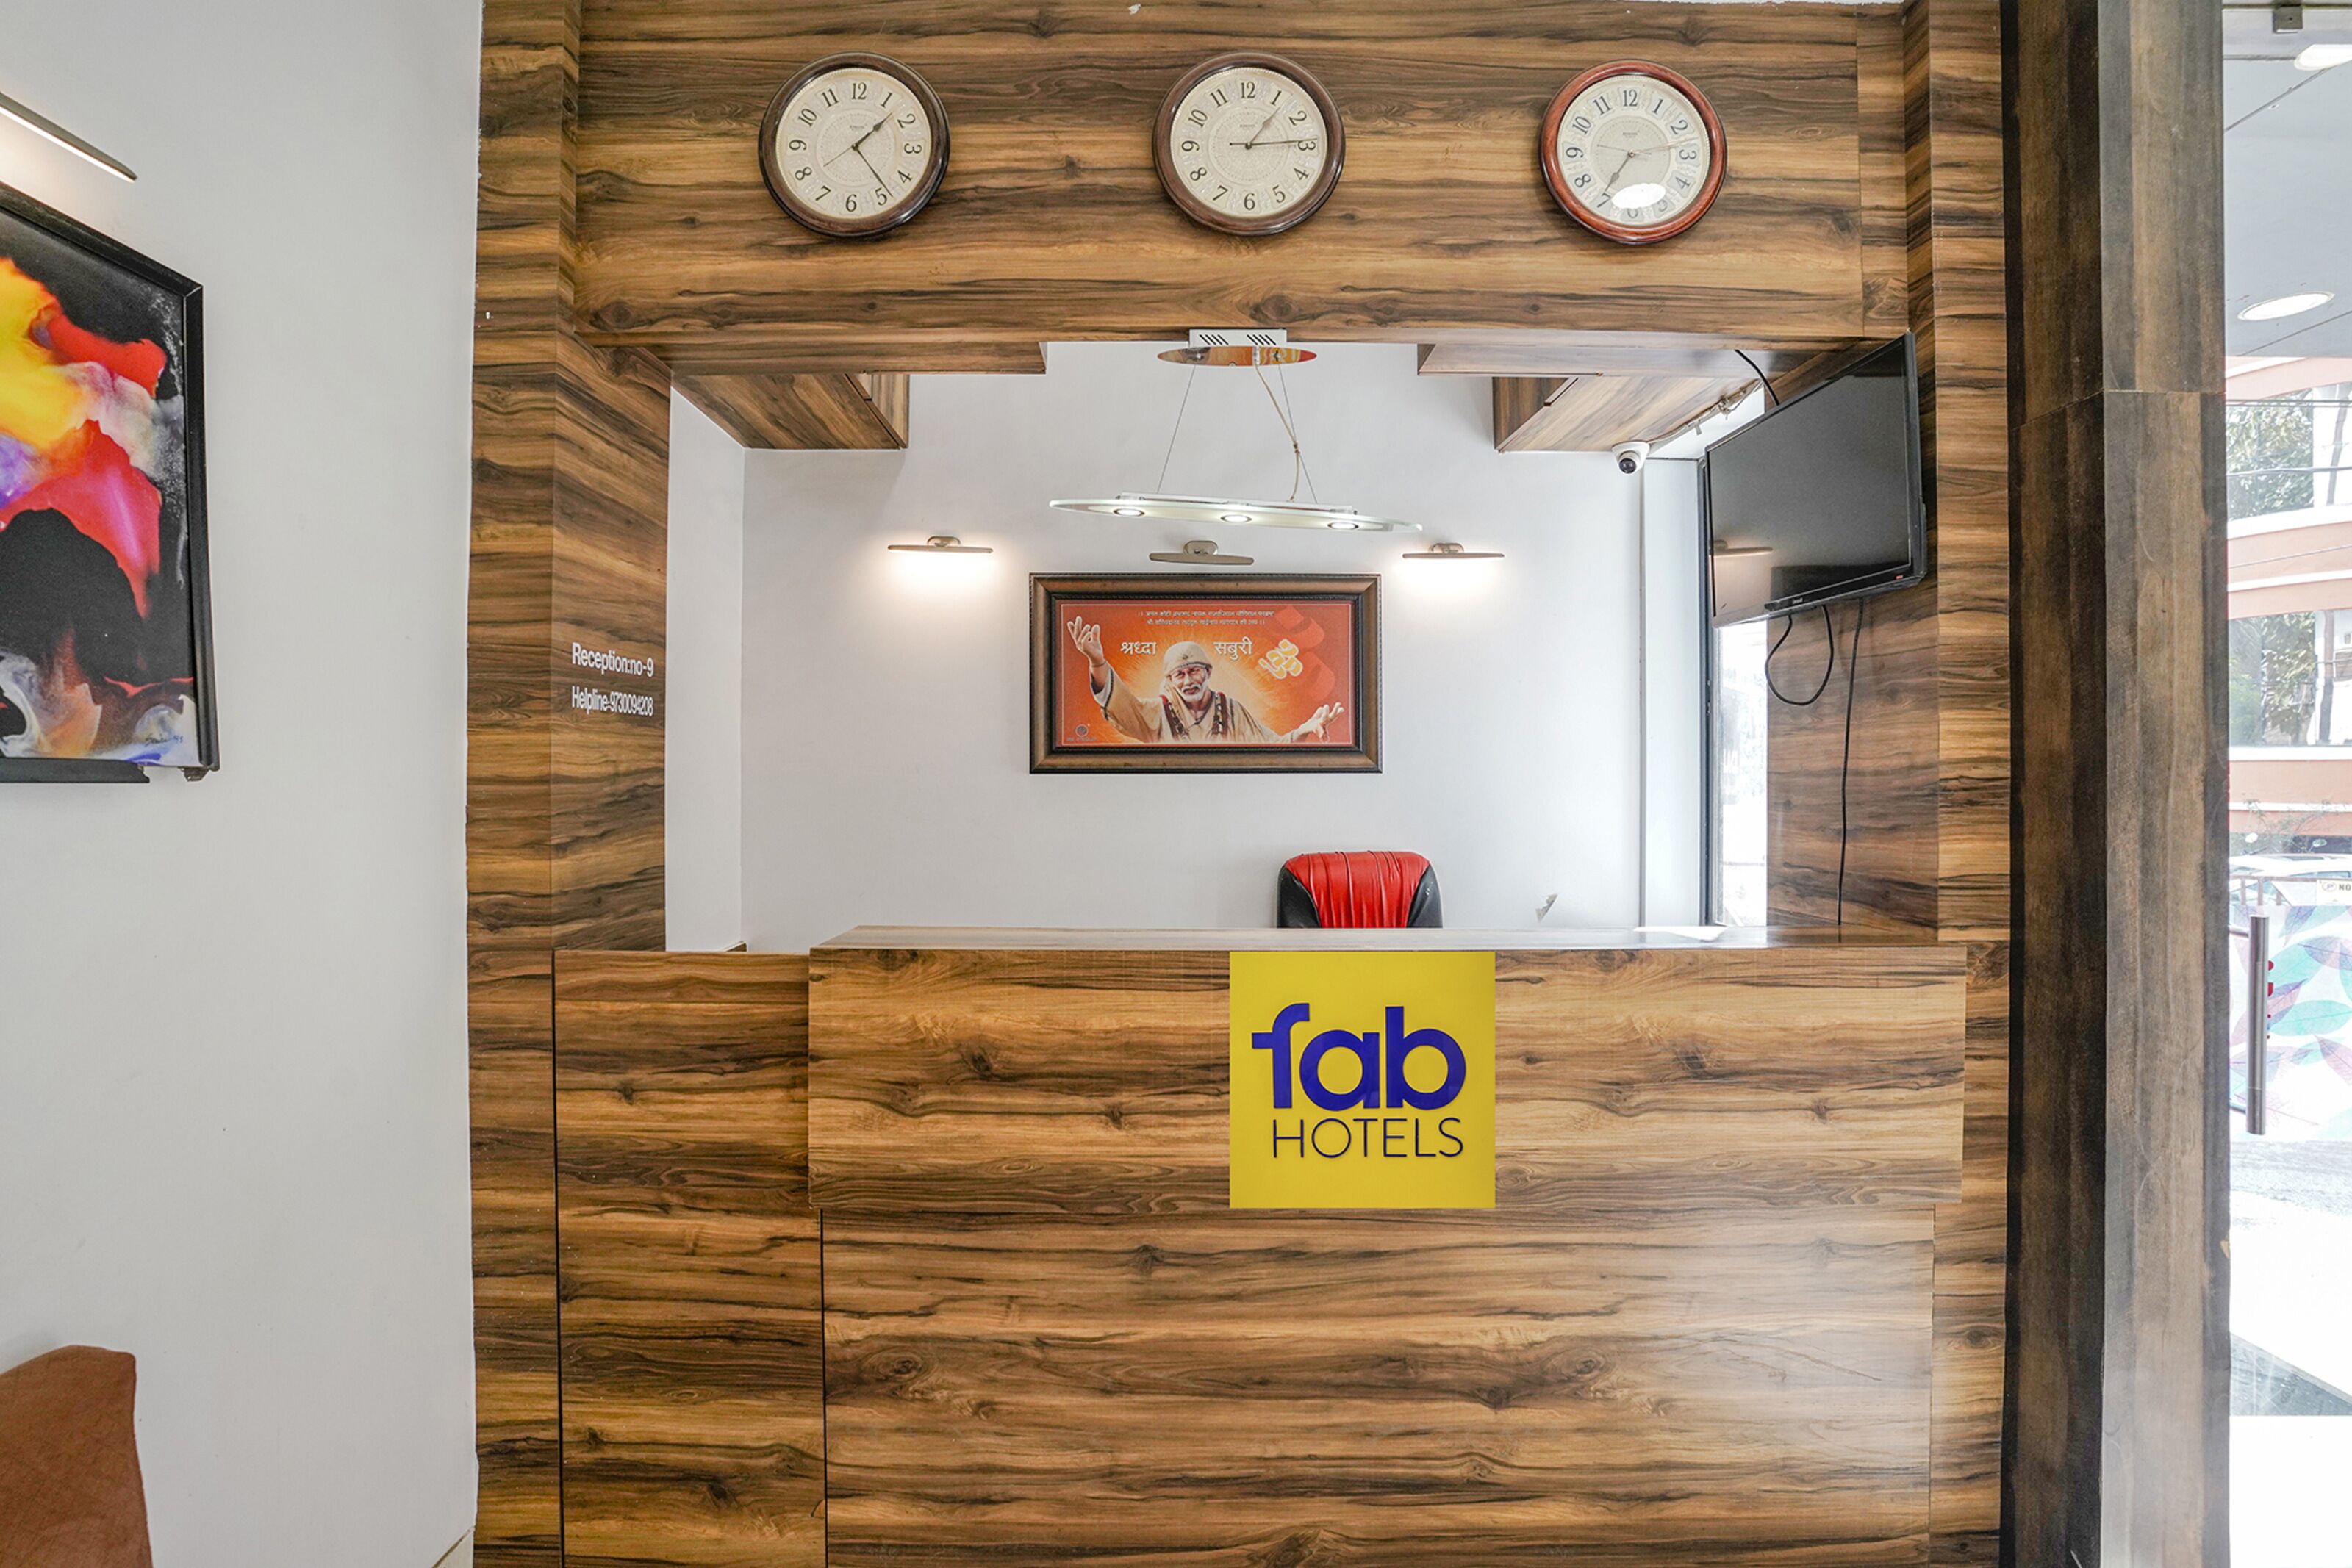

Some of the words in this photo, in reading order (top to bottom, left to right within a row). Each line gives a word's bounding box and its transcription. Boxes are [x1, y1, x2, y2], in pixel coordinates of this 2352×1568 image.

[821, 88, 839, 108] 11
[851, 82, 867, 100] 12
[1210, 89, 1229, 107] 11
[1240, 82, 1256, 98] 12
[1623, 89, 1638, 107] 12
[881, 92, 893, 109] 1
[1271, 90, 1283, 107] 1
[1593, 96, 1611, 115] 11
[1652, 99, 1664, 115] 1
[797, 109, 817, 127] 10
[897, 113, 916, 129] 2
[1188, 109, 1208, 128] 10
[1288, 111, 1307, 126] 2
[1572, 116, 1591, 134] 10
[1670, 119, 1688, 134] 2
[789, 140, 807, 151] 9
[904, 143, 922, 154] 3
[1181, 140, 1200, 152] 9
[1298, 140, 1316, 151] 3
[1566, 147, 1584, 159] 9
[1679, 149, 1697, 160] 3
[795, 167, 812, 181] 8
[897, 170, 912, 184] 4
[1190, 167, 1208, 181] 8
[1294, 168, 1310, 181] 4
[1574, 173, 1591, 187] 8
[1675, 176, 1690, 190] 4
[815, 185, 831, 201] 7
[875, 187, 888, 206] 5
[1213, 185, 1228, 201] 7
[1273, 185, 1286, 204] 5
[1596, 193, 1612, 208] 7
[845, 194, 857, 212] 6
[1244, 193, 1255, 210] 6
[1213, 636, 1253, 661] सबुरी
[1252, 1002, 1466, 1111] fab
[1273, 1117, 1463, 1158] HOTELS
